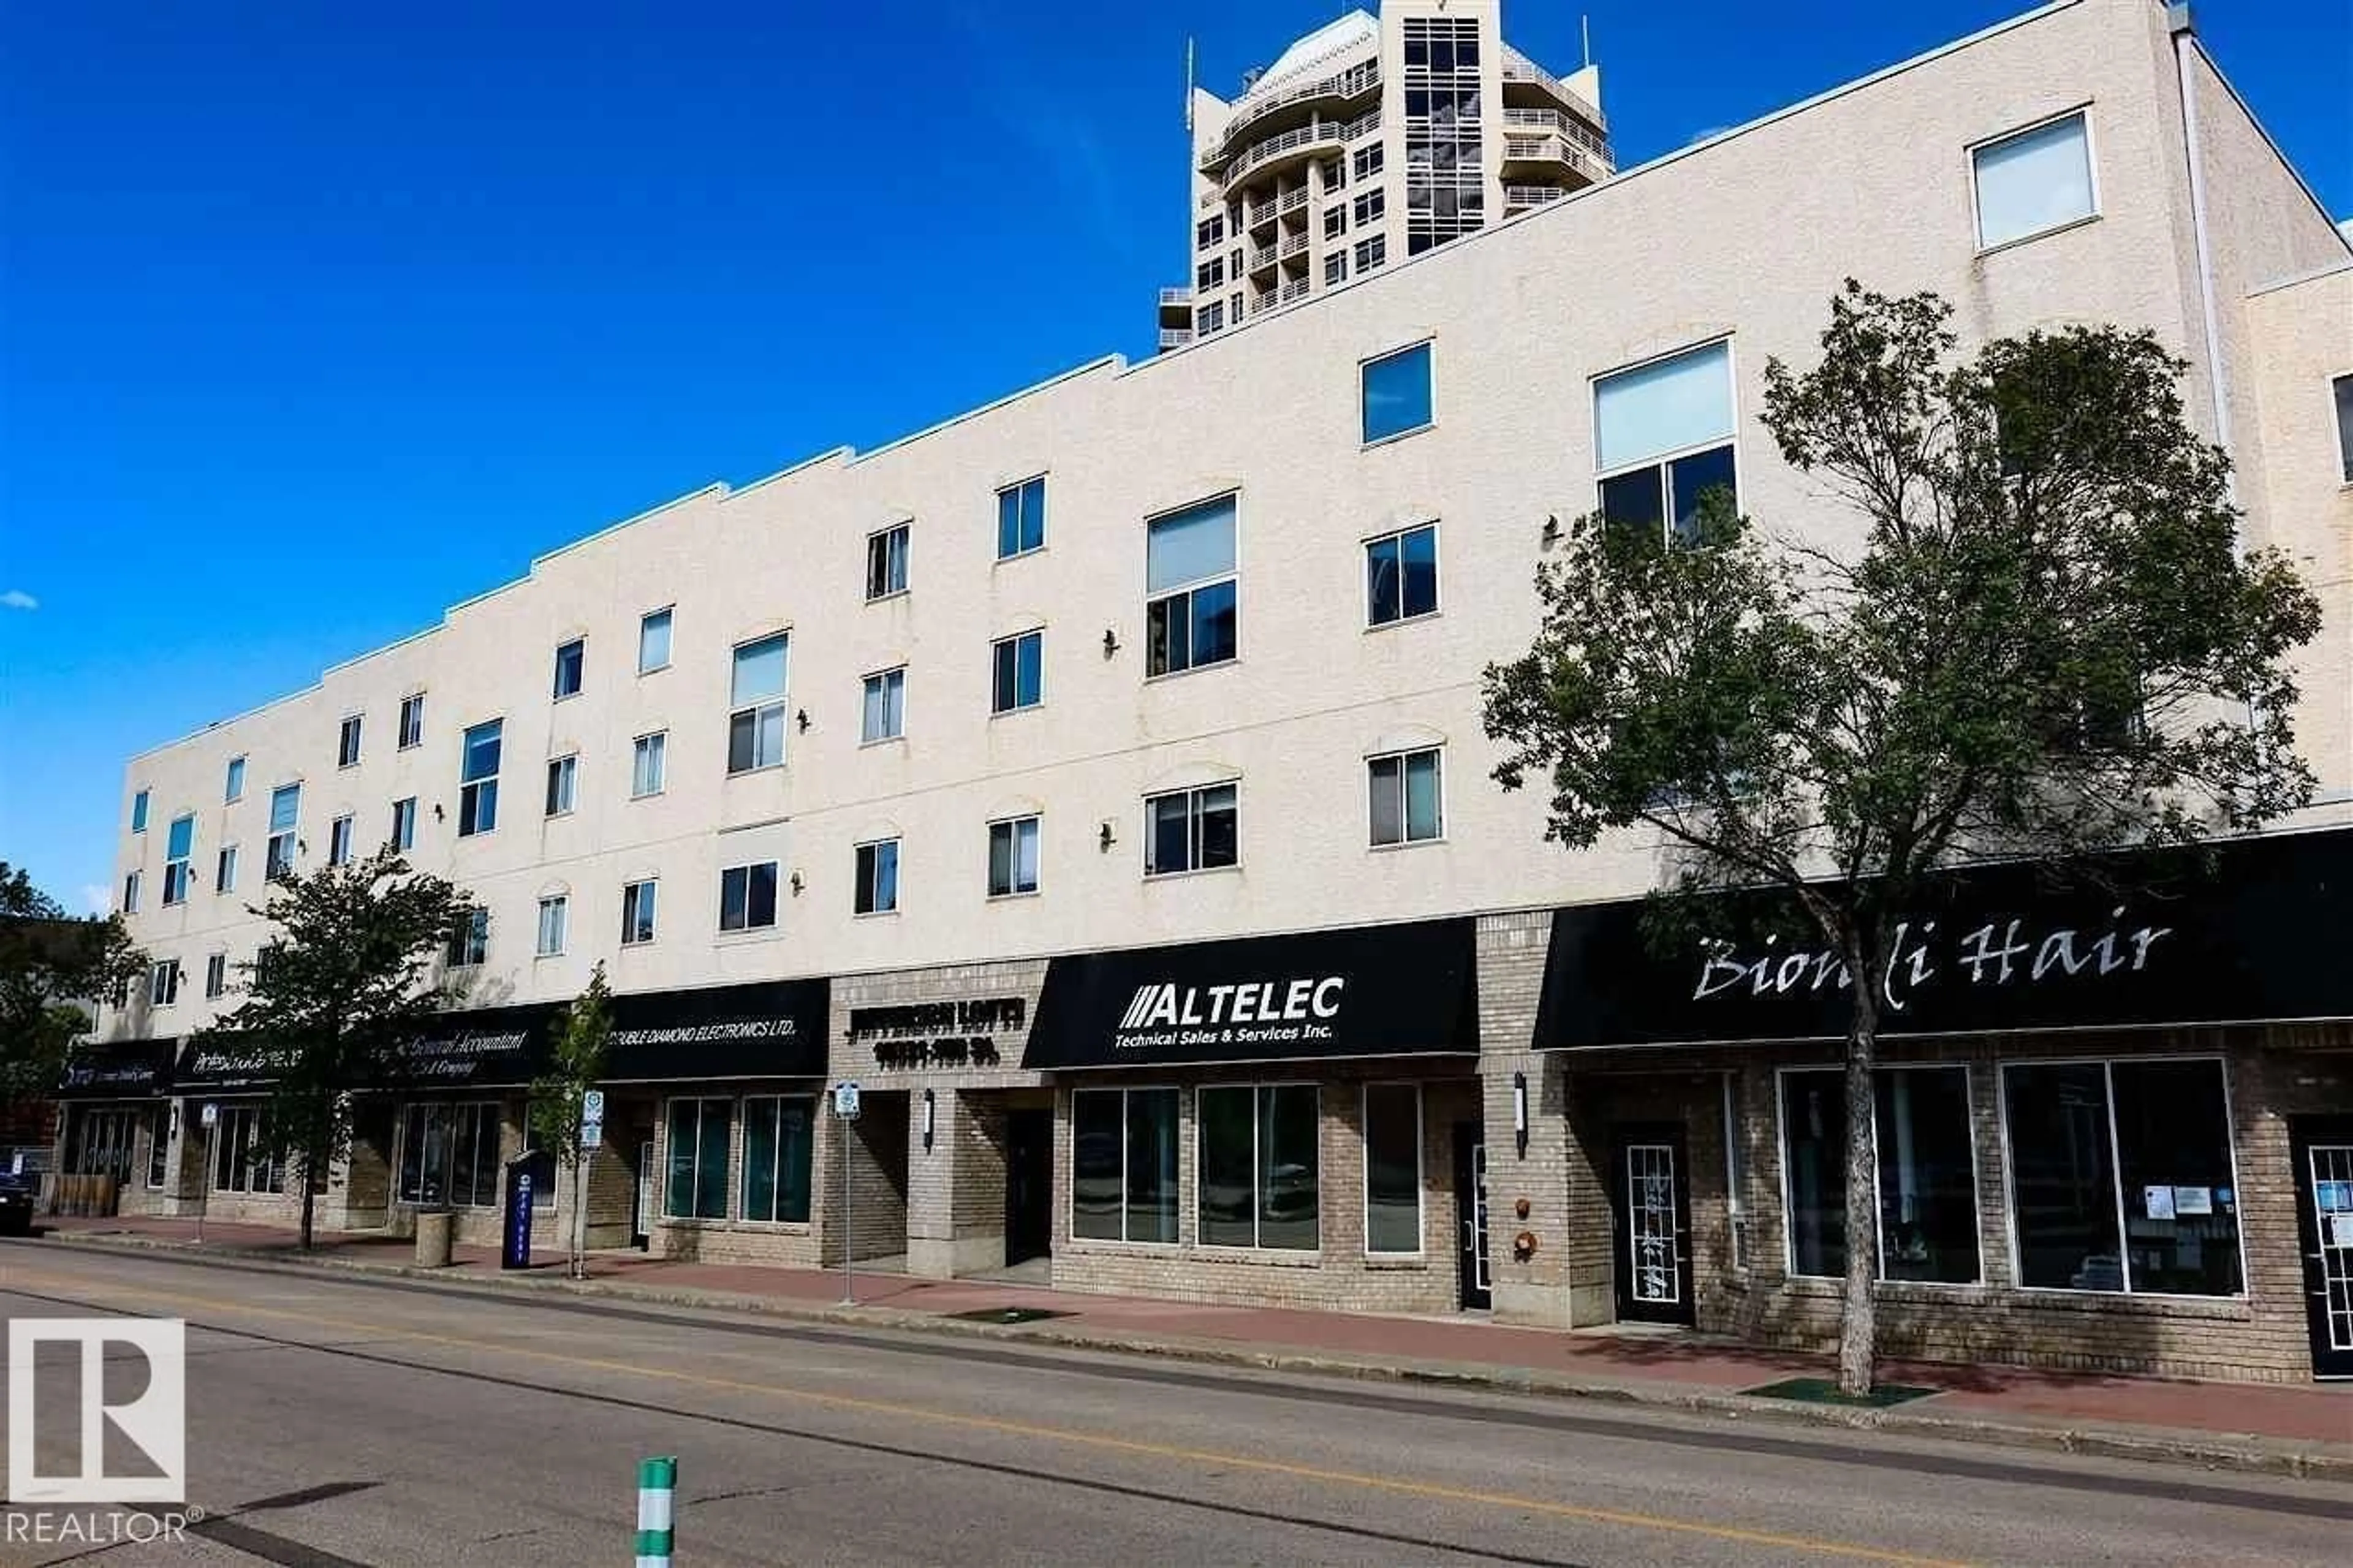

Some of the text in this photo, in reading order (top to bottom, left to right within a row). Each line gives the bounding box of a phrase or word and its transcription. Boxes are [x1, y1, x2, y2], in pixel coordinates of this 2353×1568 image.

[1958, 906, 2173, 984] Hair
[1143, 977, 1344, 1028] ALTELEC
[646, 1026, 695, 1043] DIAMOND
[695, 1021, 770, 1041] ELECTRONICS
[1115, 1023, 1332, 1048] Technical Sales & Services Inc.
